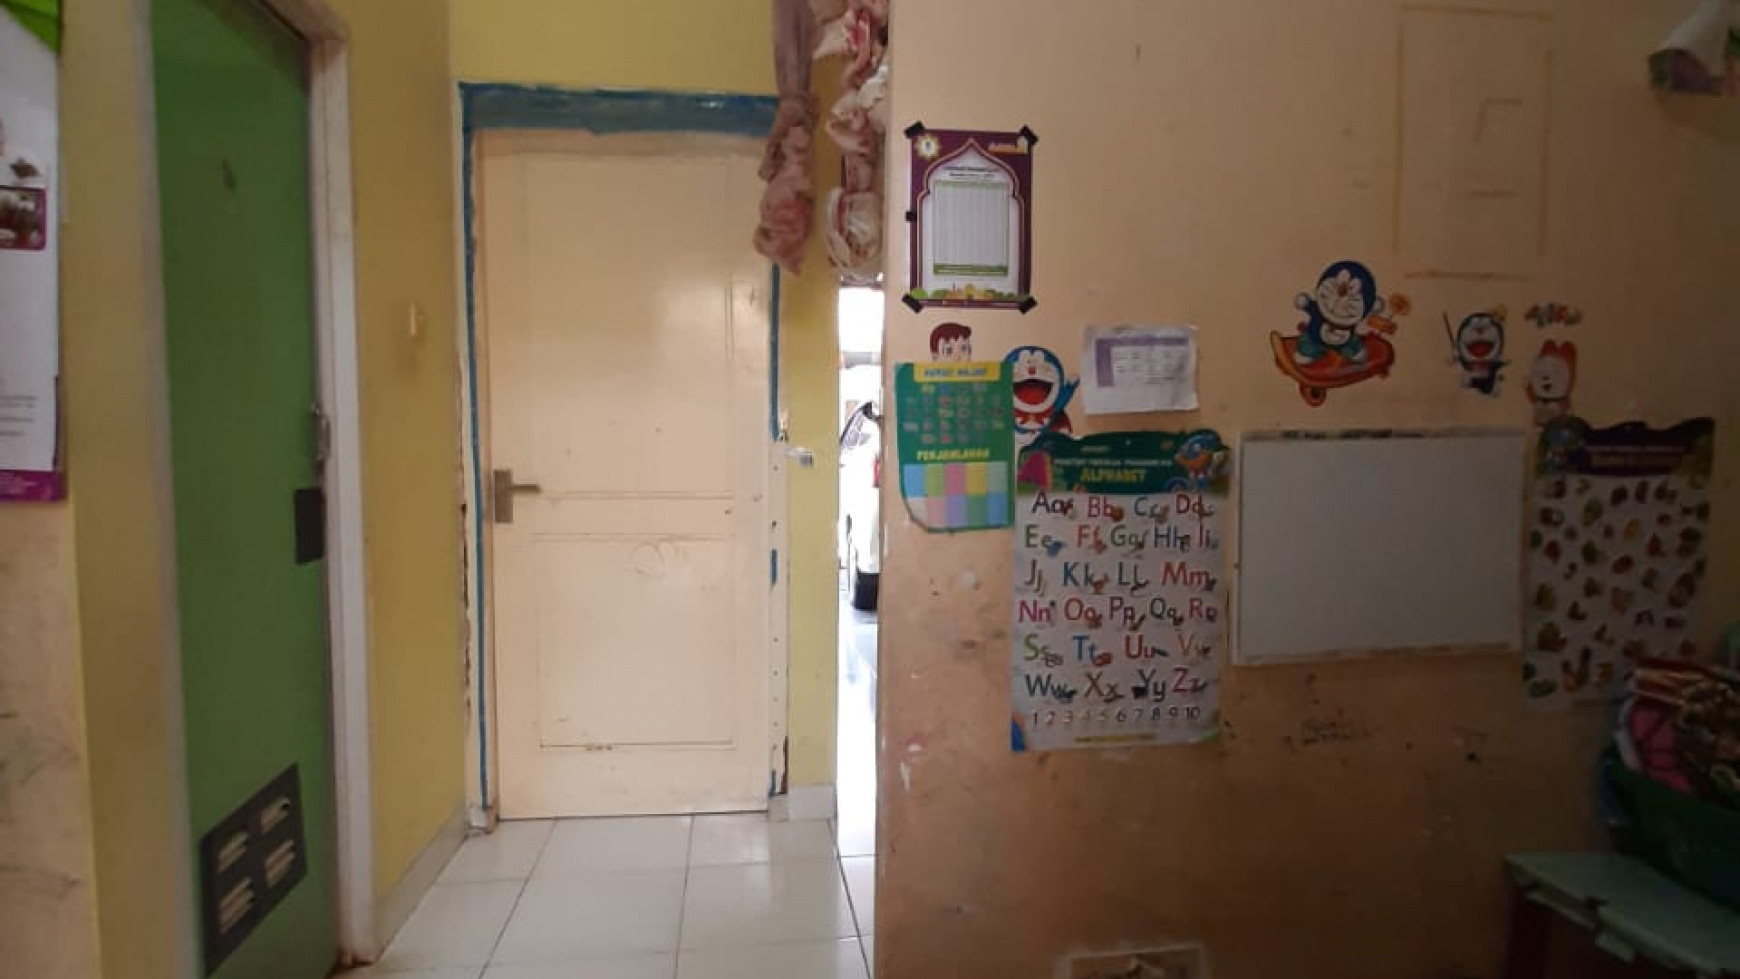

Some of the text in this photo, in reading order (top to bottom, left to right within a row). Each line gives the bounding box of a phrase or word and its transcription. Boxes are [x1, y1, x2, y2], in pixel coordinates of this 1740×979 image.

[1087, 495, 1114, 518] Bb
[1025, 524, 1051, 548] Ee
[1063, 561, 1096, 587] Kk
[1161, 561, 1211, 587] Mm
[1018, 599, 1050, 622] Nn
[1072, 634, 1096, 661] Tt
[1045, 711, 1056, 725] 2
[1063, 711, 1074, 725] 3
[1080, 708, 1092, 722] 4
[1097, 708, 1109, 721] 5
[1115, 707, 1127, 722] 6
[1132, 708, 1144, 722] 7
[1151, 707, 1161, 721] 8
[1168, 706, 1179, 720] 9
[1186, 706, 1201, 720] 10
